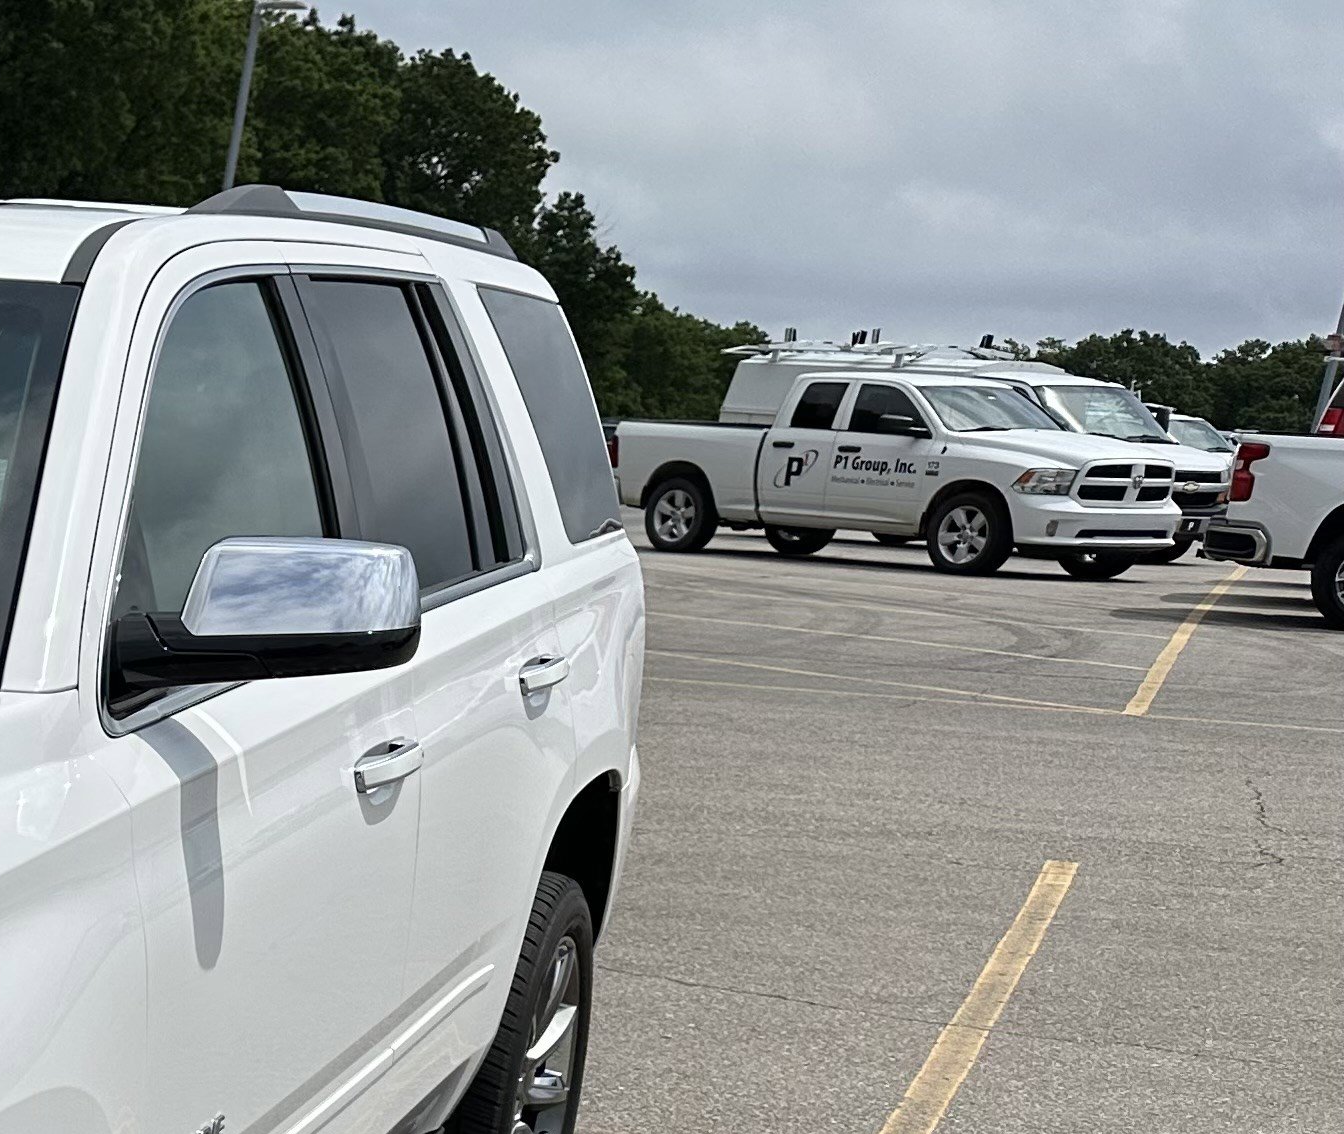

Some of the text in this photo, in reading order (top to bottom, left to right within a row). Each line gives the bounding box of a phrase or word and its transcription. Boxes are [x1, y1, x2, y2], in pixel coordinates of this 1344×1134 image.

[833, 455, 849, 470] P1
[852, 456, 891, 476] Group,
[894, 458, 917, 474] Inc.
